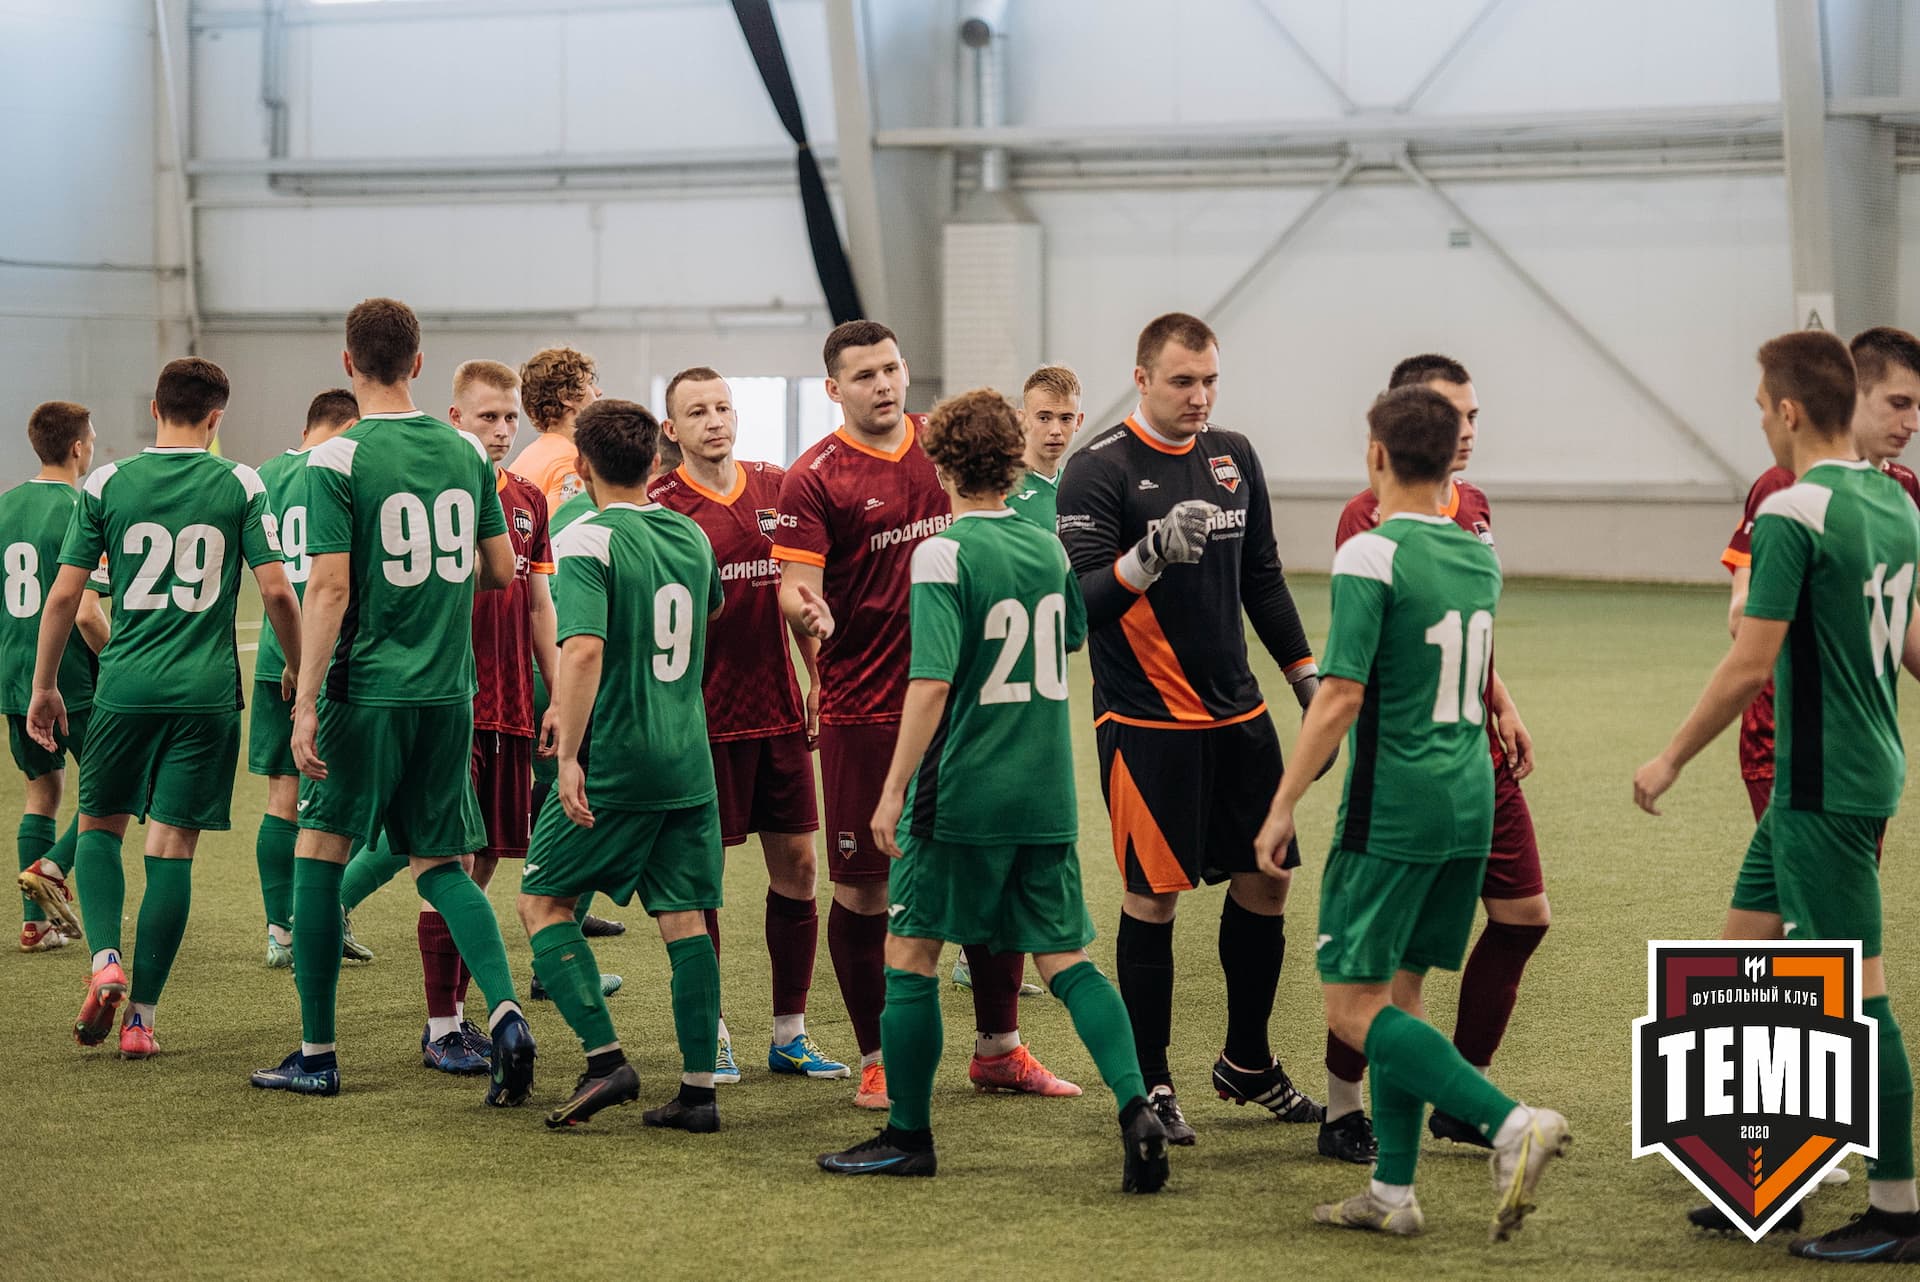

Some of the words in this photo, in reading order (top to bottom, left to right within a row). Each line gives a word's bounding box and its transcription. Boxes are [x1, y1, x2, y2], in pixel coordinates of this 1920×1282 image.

[4, 542, 41, 618] 8
[123, 522, 226, 613] 29
[380, 488, 475, 587] 99
[652, 583, 693, 682] 9
[979, 592, 1069, 706] 20
[1424, 609, 1494, 725] 10
[1863, 562, 1915, 679] 11
